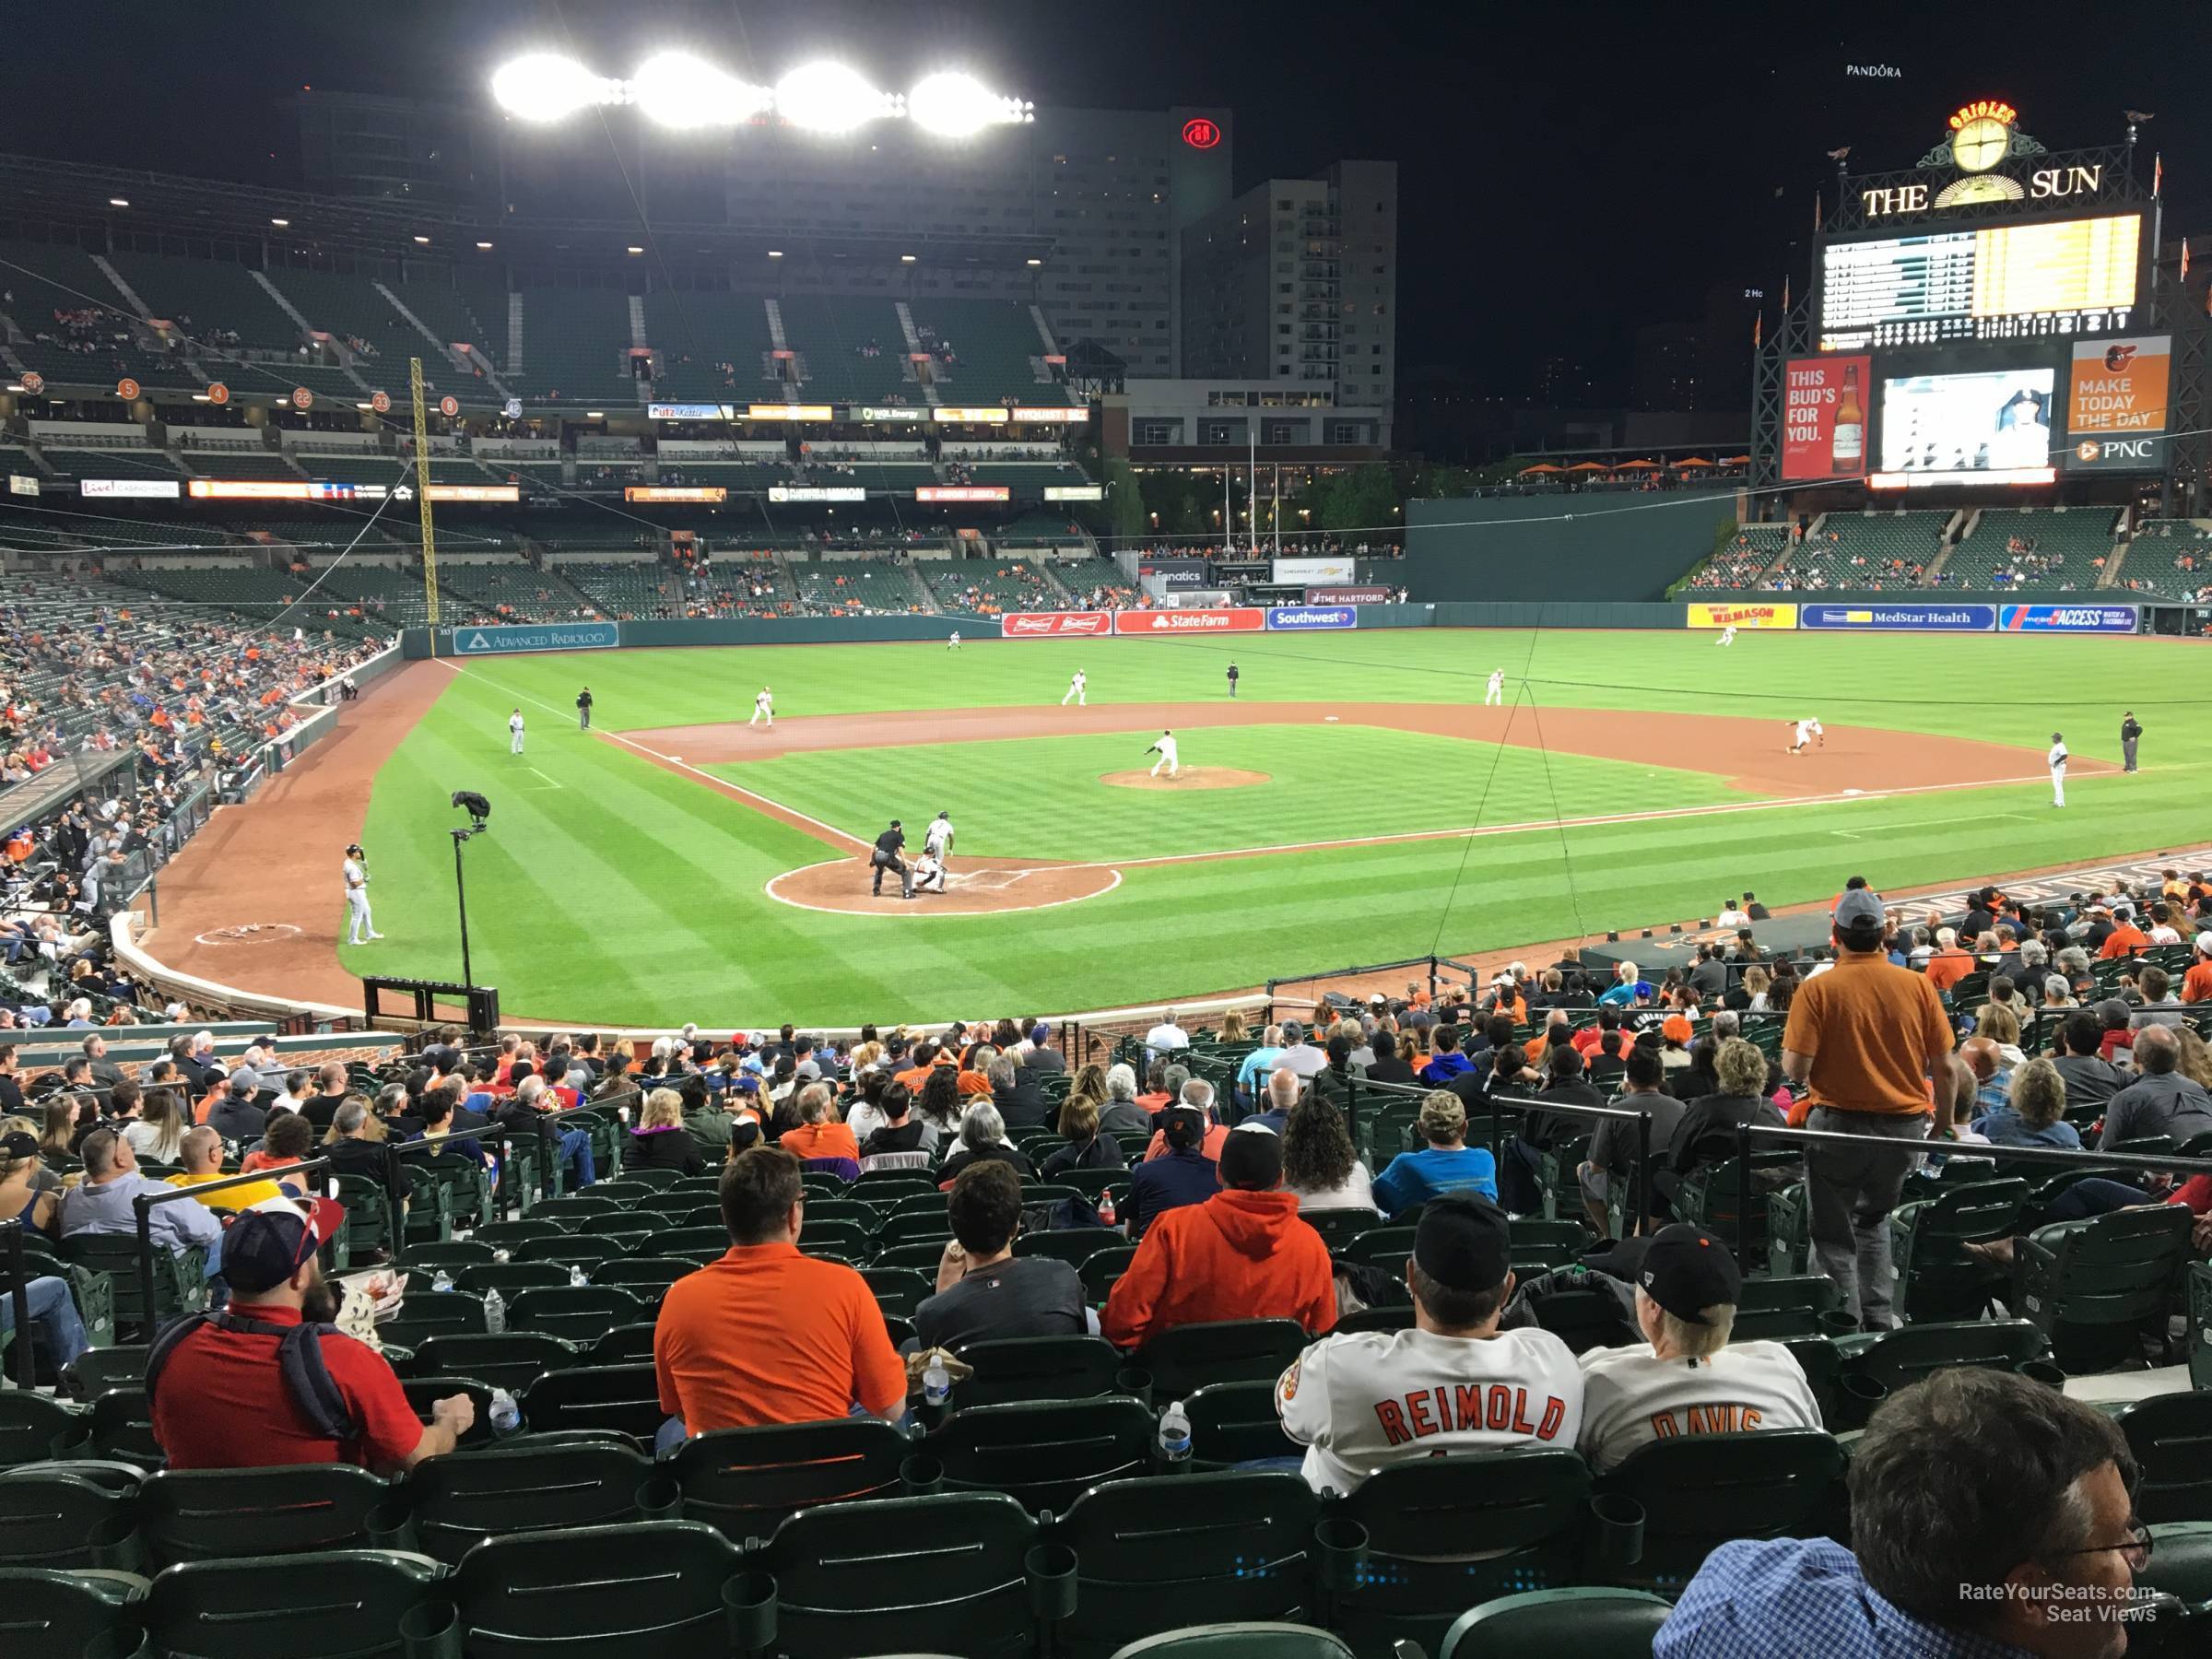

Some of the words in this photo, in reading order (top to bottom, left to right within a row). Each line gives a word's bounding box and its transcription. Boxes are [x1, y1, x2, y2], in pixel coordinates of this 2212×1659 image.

[1949, 100, 2017, 130] ORIOLES
[1863, 184, 1928, 217] THE
[2030, 165, 2101, 198] SUN
[1790, 370, 1825, 386] THIS
[2079, 378, 2132, 394] MAKE
[125, 382, 133, 394] 5
[215, 388, 222, 398] 4
[297, 393, 310, 402] 22
[375, 397, 388, 407] 33
[1789, 388, 1836, 406] BUD'S
[2077, 394, 2136, 411] TODAY
[446, 399, 453, 412] 8
[509, 404, 520, 416] 42
[892, 409, 919, 419] Energy
[1788, 407, 1818, 424] FOR
[2077, 413, 2112, 428] THE
[2116, 411, 2151, 427] DAY
[1788, 426, 1822, 442] YOU.
[2103, 441, 2154, 458] PNC
[1156, 571, 1201, 582] Fanatics
[1339, 594, 1383, 603] HARTFORD
[1277, 612, 1339, 624] Southwest
[1875, 612, 1924, 623] MedStar
[1928, 612, 1971, 623] Health
[2057, 609, 2102, 627] ACCESS
[493, 635, 547, 647] ADVANCED
[551, 632, 606, 644] RADIOLOGY
[1373, 1384, 1566, 1446] REIMOLD
[1652, 1405, 1762, 1439] DAVIS
